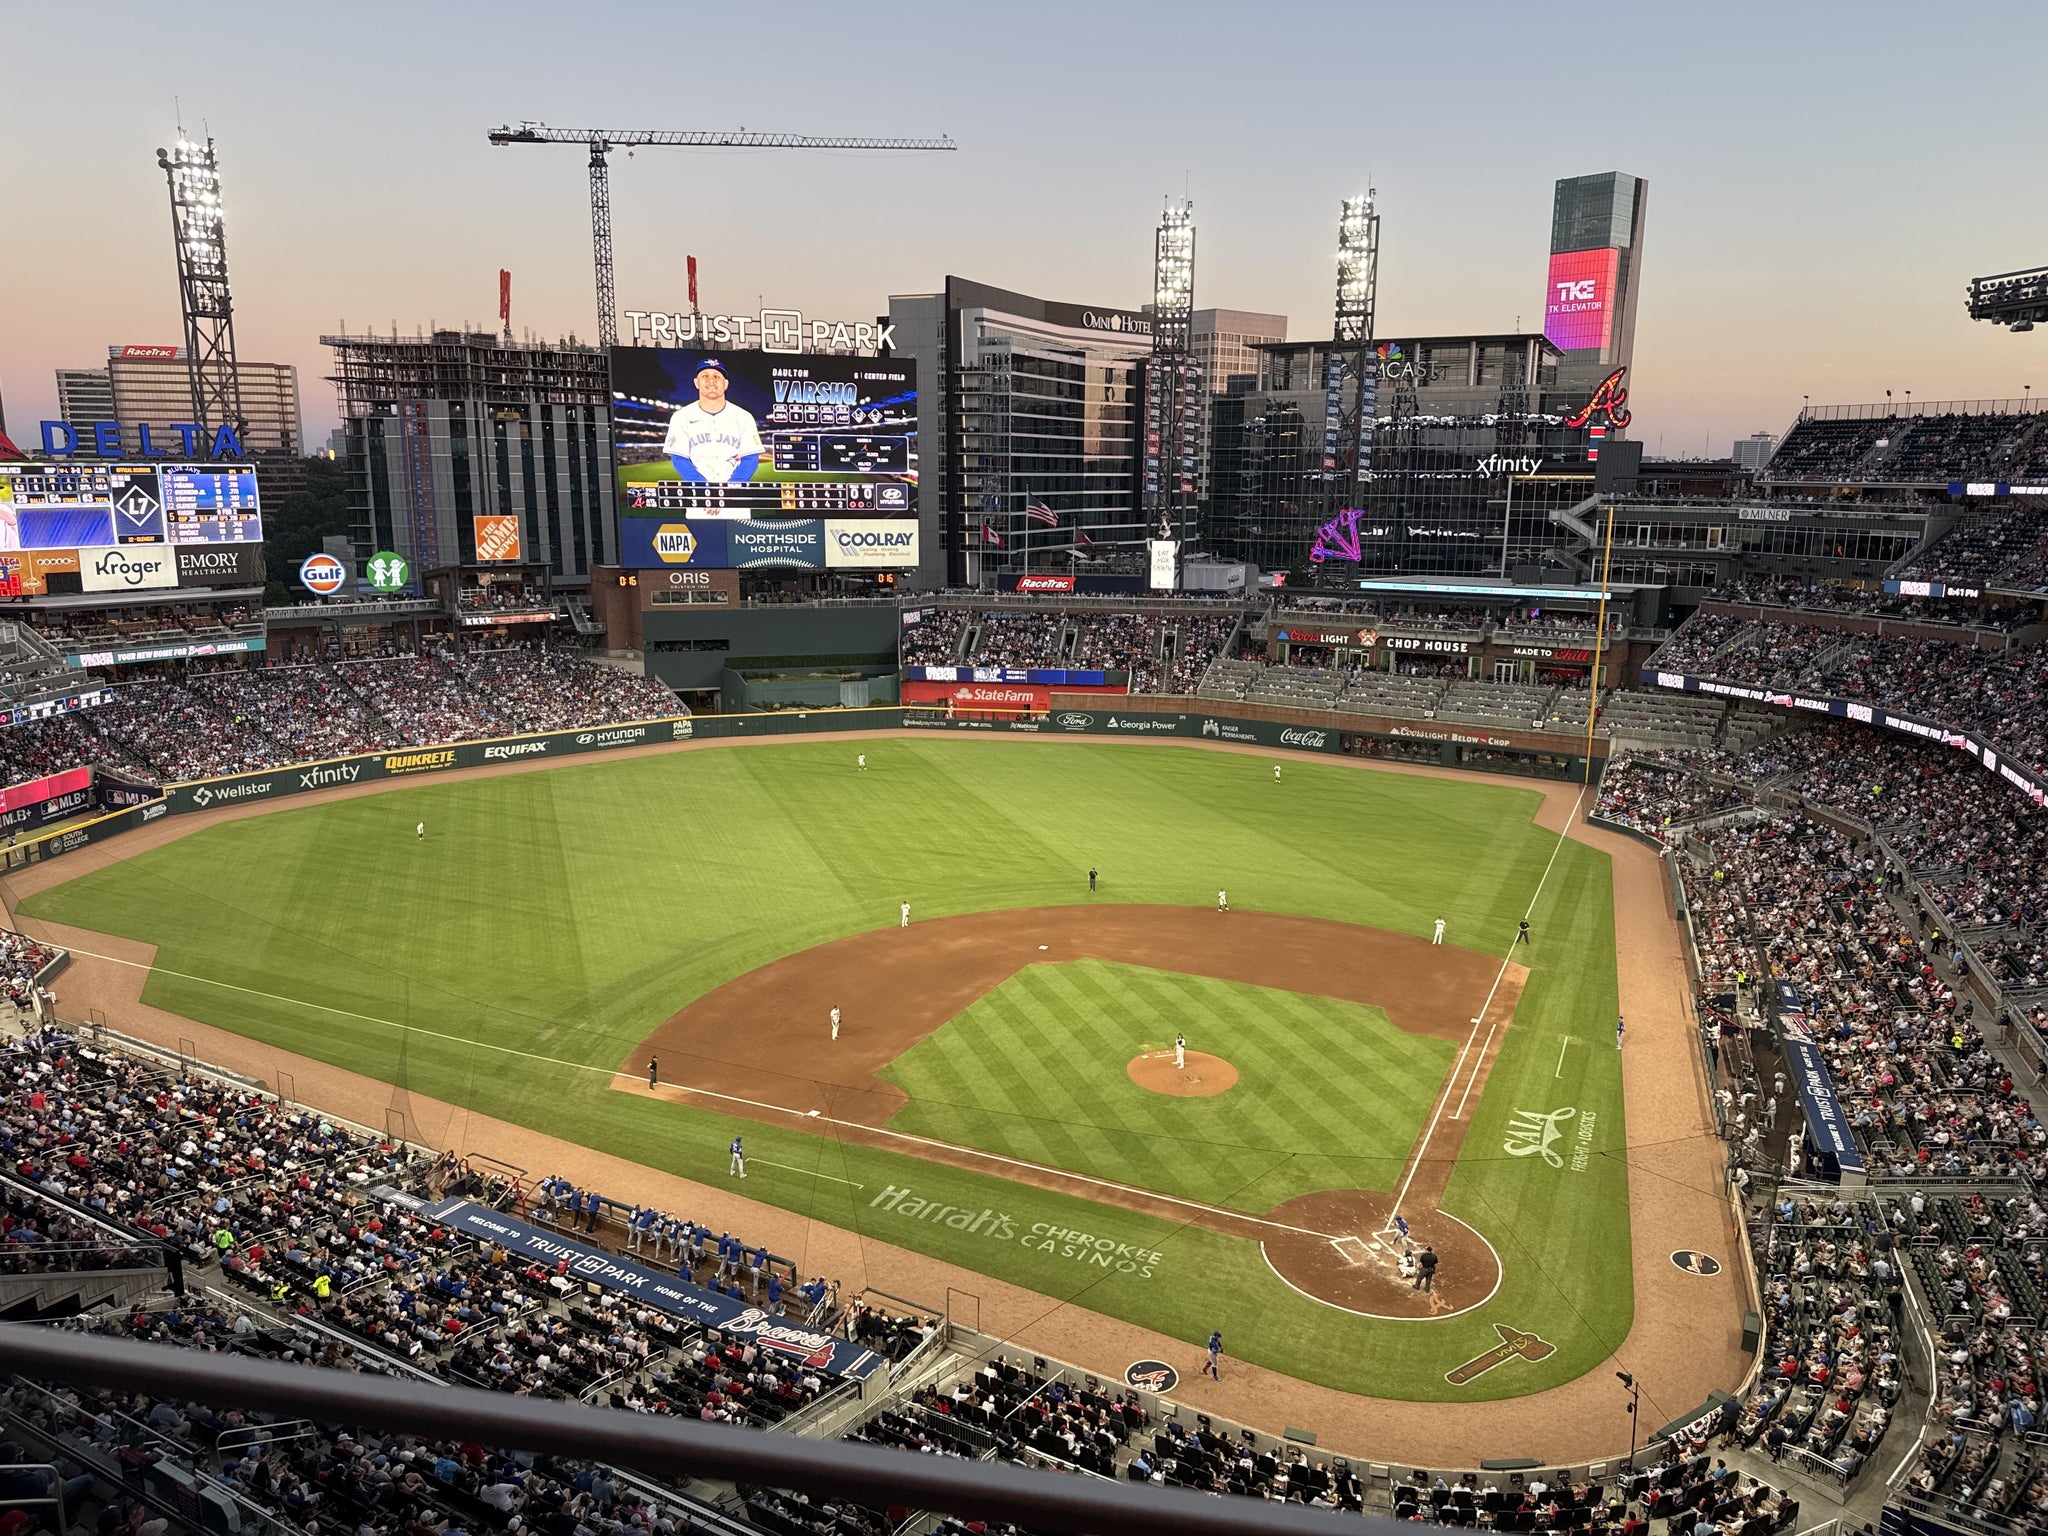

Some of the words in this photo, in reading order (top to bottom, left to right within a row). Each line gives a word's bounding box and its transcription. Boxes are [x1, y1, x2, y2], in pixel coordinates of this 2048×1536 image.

[1557, 280, 1595, 301] TKE
[1561, 302, 1602, 312] ELEVATOR
[625, 311, 752, 343] TRUIST
[812, 319, 898, 350] PARK
[126, 348, 171, 357] RaceTrac
[772, 368, 809, 377] DAULTON
[864, 372, 886, 380] CENTER
[773, 380, 858, 405] VARSHO
[40, 420, 244, 457] DELTA
[167, 465, 183, 474] BLUE
[184, 465, 201, 474] JAYS
[1476, 454, 1542, 476] xfinity
[850, 489, 859, 499] 0
[863, 489, 872, 499] 0
[129, 498, 148, 514] L7
[169, 512, 175, 521] 5
[1750, 509, 1789, 521] MILNER
[480, 520, 498, 539] THE
[477, 516, 518, 559] HOME
[494, 531, 519, 559] DEPOT
[660, 535, 690, 552] NAPA
[735, 534, 817, 544] NORTHSIDE
[838, 533, 914, 547] COOLRAY
[180, 552, 239, 568] EMORY
[96, 551, 161, 585] Kroger
[181, 567, 238, 576] HEALTHCARE
[304, 568, 342, 581] Gulf
[669, 573, 710, 584] ORIS
[1021, 579, 1069, 588] RaceTrac
[1965, 588, 1979, 598] PM
[1289, 629, 1320, 642] Coors
[1320, 634, 1349, 644] LIGHT
[118, 653, 136, 661] YOUR
[137, 651, 152, 660] NEW
[153, 650, 173, 658] HOME
[174, 649, 187, 657] FOR
[217, 642, 248, 652] BASEBALL
[1387, 638, 1421, 650] CHOP
[1425, 641, 1468, 652] HOUSE
[1513, 648, 1539, 657] MADE
[1541, 649, 1552, 657] TO
[1553, 648, 1590, 662] Chill
[926, 672, 957, 680] VISION
[1699, 682, 1714, 692] YOUR
[1714, 685, 1730, 694] NEW
[1730, 687, 1750, 698] HOME
[1750, 690, 1763, 700] FOR
[1794, 698, 1829, 711] BASEBALL
[673, 720, 692, 729] PAPA
[1063, 715, 1088, 726] Ford
[1120, 721, 1150, 730] Georgia
[1152, 721, 1176, 730] Power
[597, 728, 645, 742] HYUNDAI
[673, 727, 693, 736] JOHNS
[1222, 732, 1256, 740] PERMANENTE
[1280, 728, 1328, 748] Coca-Cola
[1400, 727, 1424, 737] Coors
[1425, 732, 1448, 740] LIGHT
[1930, 728, 1942, 740] FOR
[484, 742, 547, 758] EQUIFAX
[385, 751, 455, 769] QUIKRETE
[300, 764, 360, 789] xfinity
[406, 765, 429, 773] America's
[215, 782, 272, 800] Wellstar
[59, 792, 87, 809] MLB+
[2, 809, 32, 827] MB+
[62, 830, 84, 840] SOUTH
[63, 836, 89, 847] COLLEGE
[1577, 1111, 1597, 1141] LOGISTICS
[1571, 1145, 1590, 1173] FREIGHT
[869, 1185, 1019, 1240] Harrah's
[467, 1214, 506, 1234] WELCOME
[508, 1230, 521, 1238] TO
[1031, 1222, 1162, 1265] CHEROKEE
[526, 1236, 585, 1262] TRUIST
[600, 1264, 650, 1288] PARK
[1021, 1234, 1153, 1278] CASINOS
[654, 1285, 682, 1301] HOME
[683, 1295, 697, 1305] OF
[698, 1300, 718, 1313] THE
[718, 1308, 831, 1348] Braves
